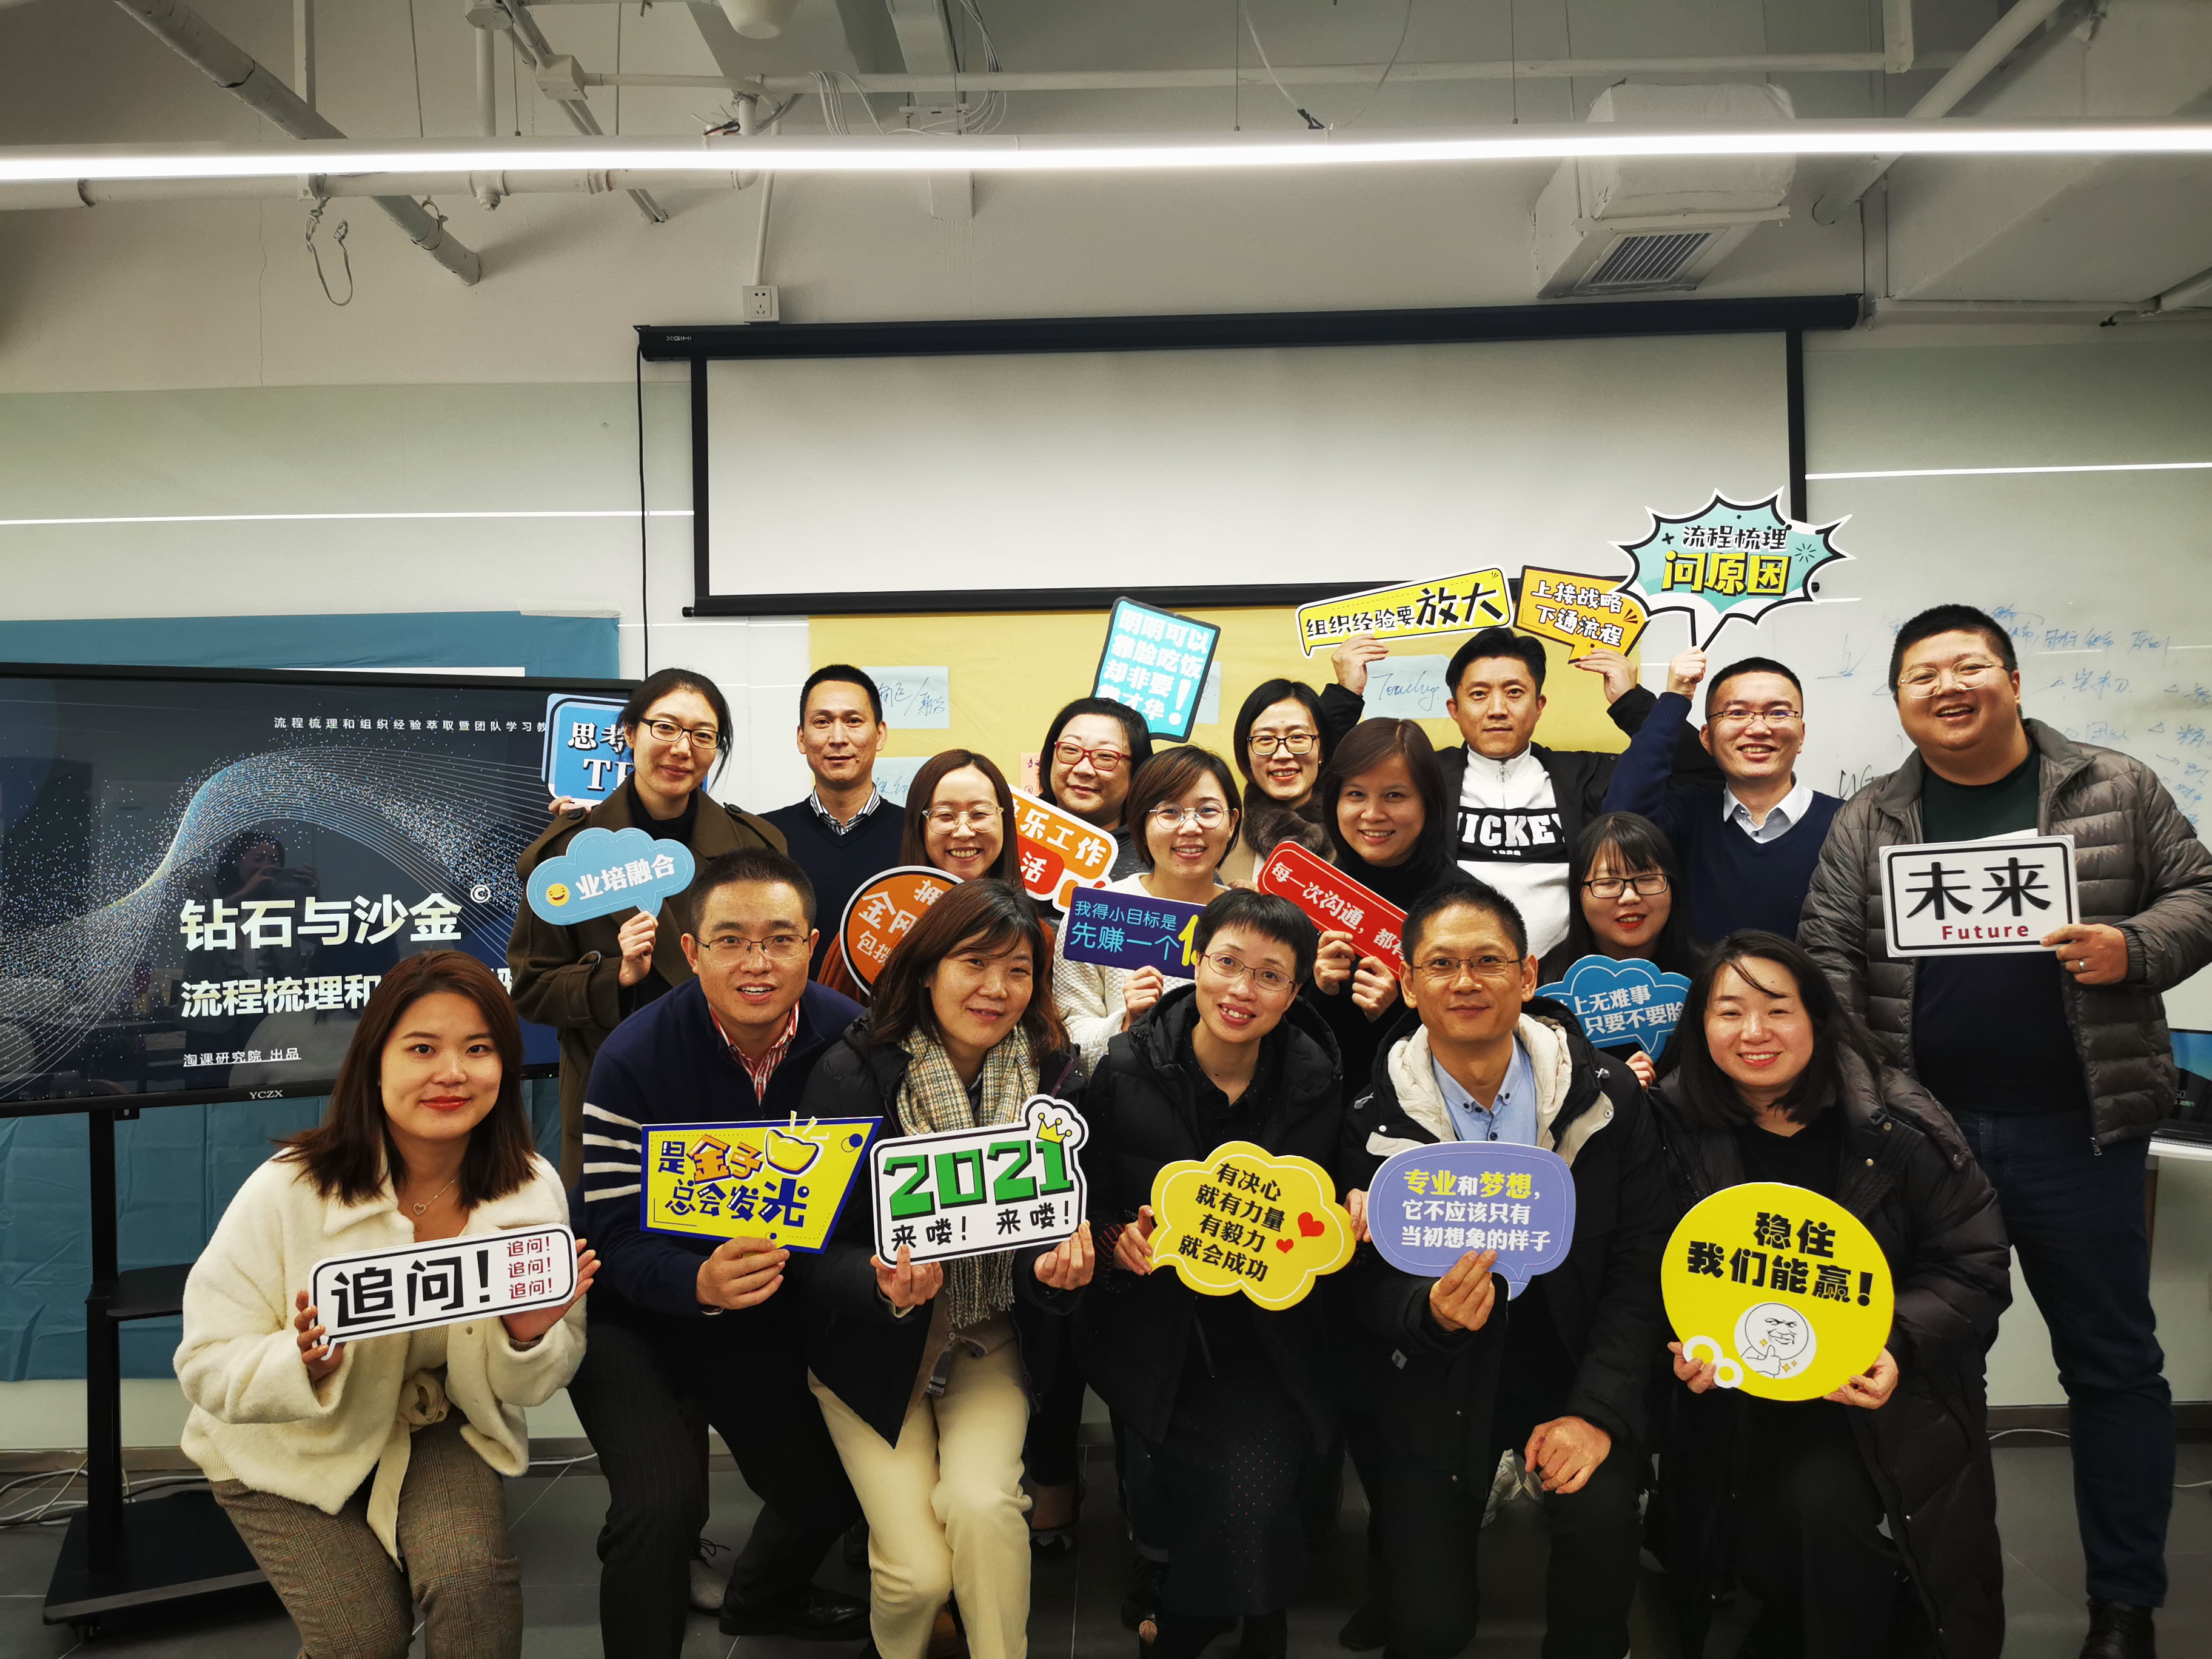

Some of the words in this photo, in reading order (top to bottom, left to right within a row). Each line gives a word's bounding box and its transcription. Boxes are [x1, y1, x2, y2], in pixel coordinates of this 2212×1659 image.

[1682, 525, 1788, 551] 流程梳理
[1661, 550, 1791, 597] 问原因
[1305, 582, 1503, 637] 组织经验要放大
[1530, 580, 1624, 614] 上接战略
[1118, 608, 1209, 655] 明明可以
[1535, 604, 1624, 647] 下通流程
[1457, 812, 1566, 846] ICKE
[575, 854, 675, 900] 业培融合
[1905, 857, 2052, 920] 未来
[180, 893, 463, 951] 钻石与沙金
[1074, 900, 1177, 931] 我得小目标是
[1942, 925, 2029, 940] Future
[181, 974, 383, 1018] 流程梳理和
[1559, 984, 1652, 1016] 上无难事
[183, 1050, 262, 1066] 淘课研究院
[270, 1047, 300, 1061] 出品
[249, 1090, 284, 1099] YCZX
[658, 1133, 763, 1185] 是金子
[883, 1139, 1075, 1222] 2021
[665, 1178, 810, 1228] 总会发光
[1216, 1162, 1282, 1202] 有决心
[1195, 1183, 1285, 1232] 就有力量
[1401, 1199, 1532, 1225] 它不应该只有
[1199, 1213, 1266, 1253] 有毅力
[1401, 1225, 1551, 1252] 当初想象的样子
[1753, 1212, 1836, 1259] 稳住
[1178, 1234, 1269, 1282] 就会成功
